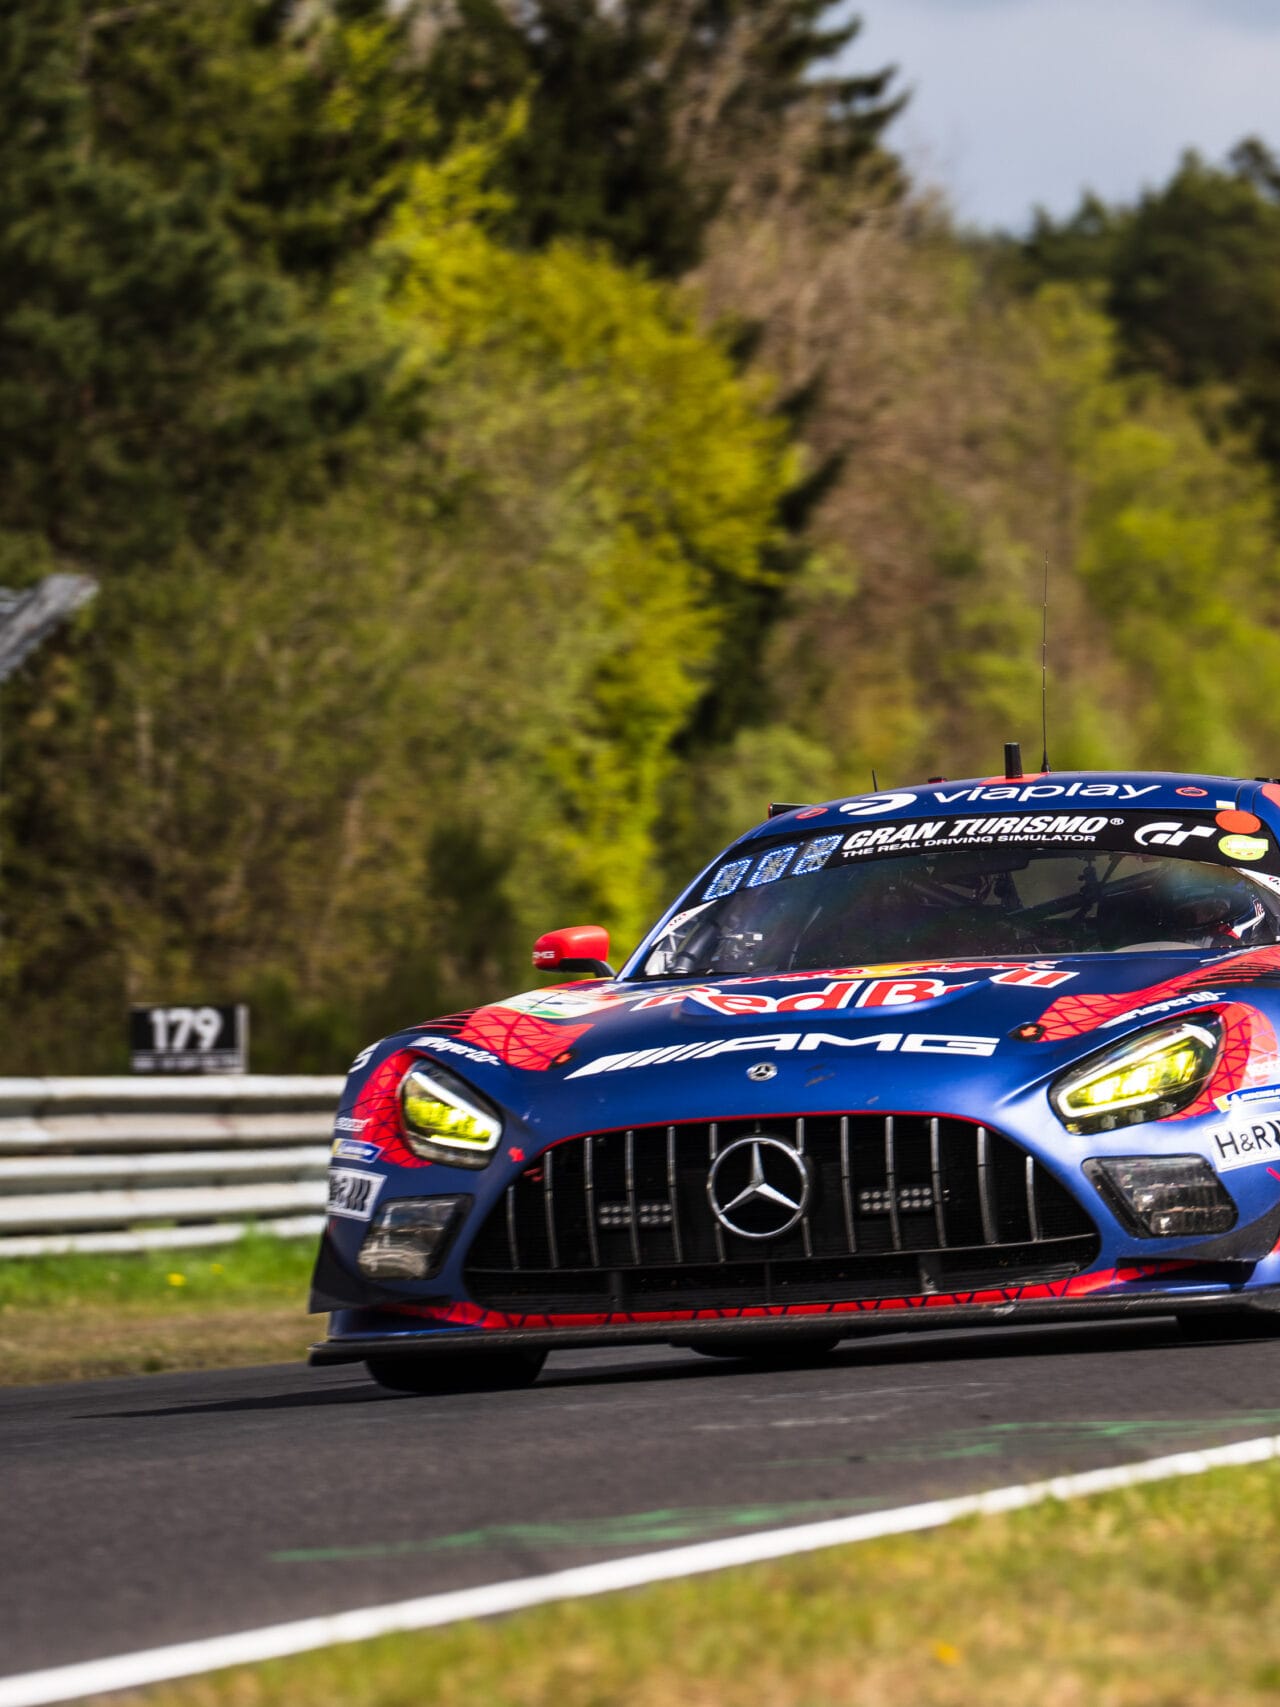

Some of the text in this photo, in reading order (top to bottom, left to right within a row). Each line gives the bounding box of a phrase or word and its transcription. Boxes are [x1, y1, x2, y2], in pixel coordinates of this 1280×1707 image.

[932, 782, 1162, 802] viaplay
[841, 820, 947, 850] GRAN
[841, 834, 1096, 858] THE REAL DRIVING SIMULATOR
[151, 1007, 222, 1054] 179
[1214, 1125, 1273, 1159] H&R
